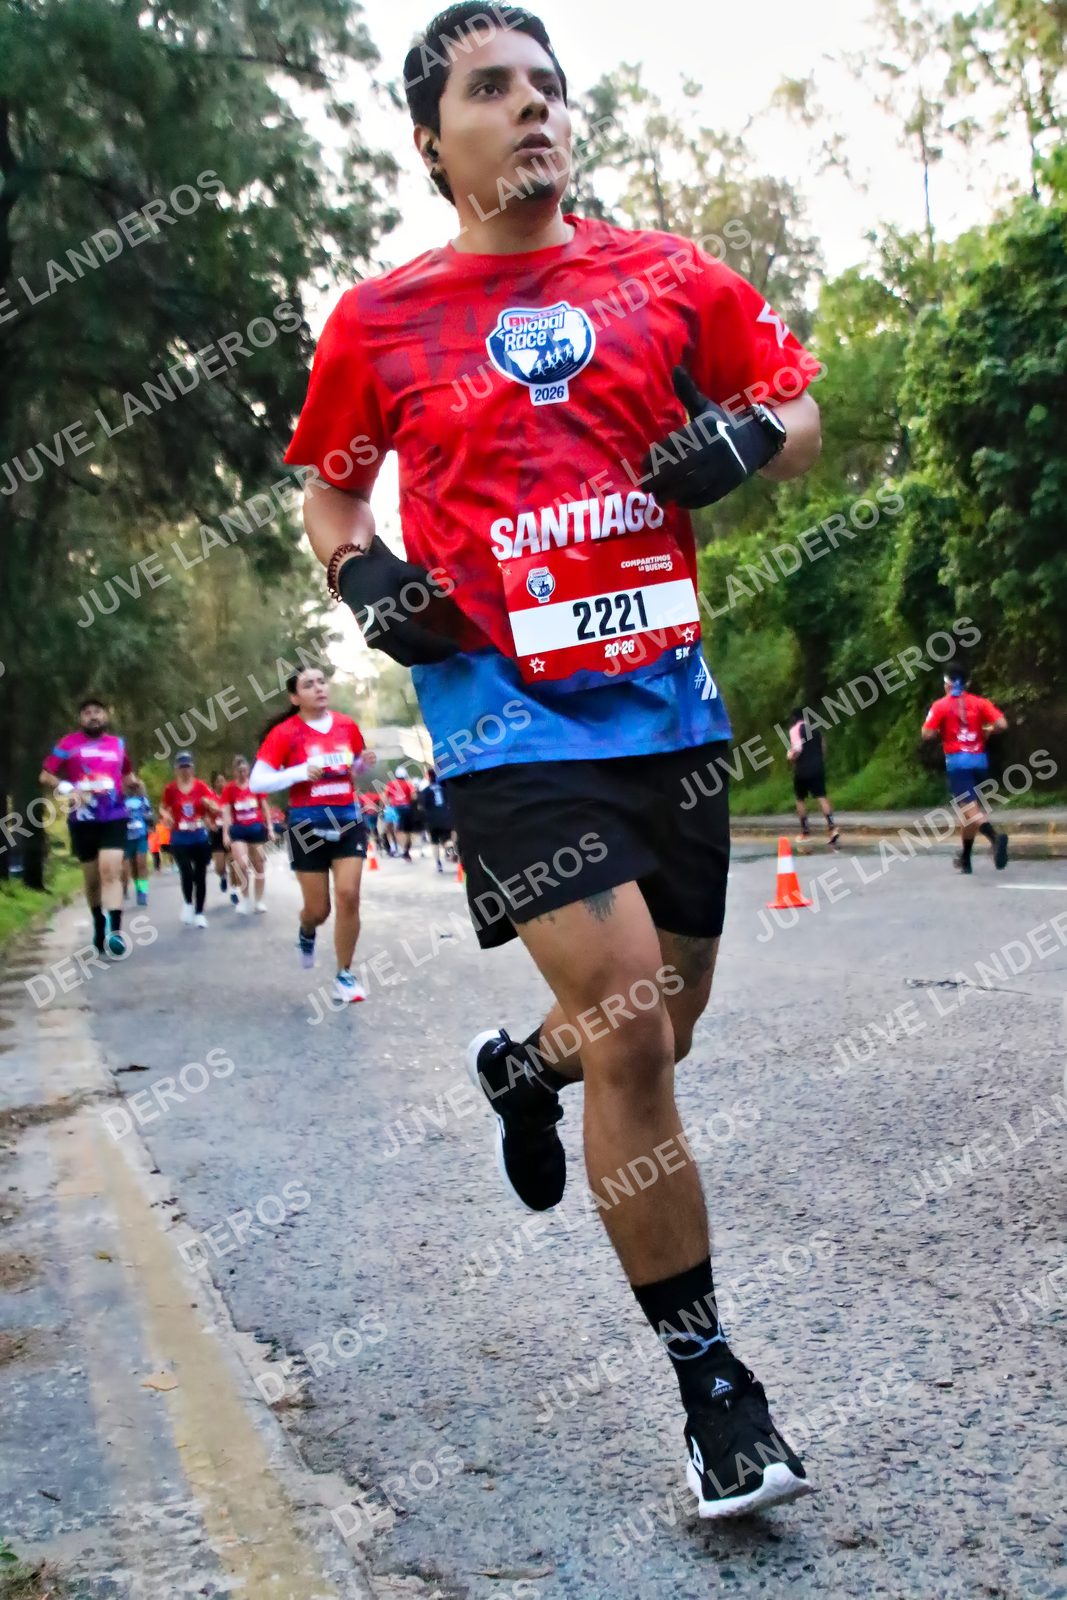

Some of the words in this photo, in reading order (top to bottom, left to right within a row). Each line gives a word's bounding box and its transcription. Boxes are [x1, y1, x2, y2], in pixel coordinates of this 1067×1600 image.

[504, 330, 547, 352] Race
[534, 386, 565, 403] 2026
[490, 492, 664, 561] SANTIAGO
[621, 554, 671, 569] COMPARTIMOS
[573, 591, 649, 641] 2221
